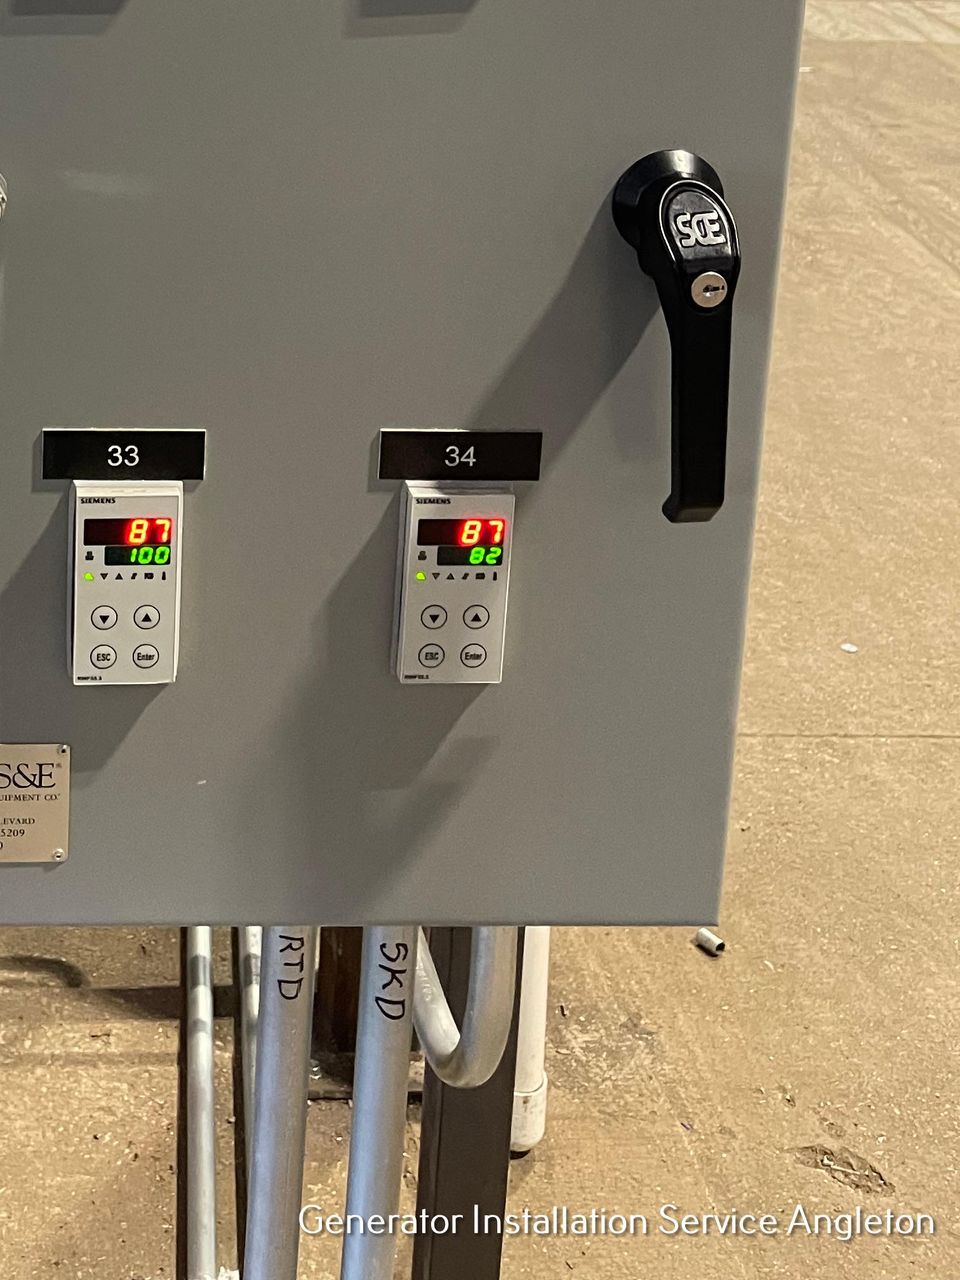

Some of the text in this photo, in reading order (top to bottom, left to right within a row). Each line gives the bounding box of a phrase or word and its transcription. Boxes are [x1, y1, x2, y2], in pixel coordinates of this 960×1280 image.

[676, 209, 727, 247] SCE
[107, 445, 140, 467] 33
[444, 445, 477, 467] 34
[128, 519, 171, 543] 87
[461, 520, 504, 544] 87
[130, 546, 170, 564] 100
[469, 547, 502, 564] 82
[96, 652, 111, 662] ESC
[136, 652, 155, 661] Enter
[424, 652, 439, 661] ESC
[464, 652, 483, 661] Enter
[277, 935, 305, 1001] RTD
